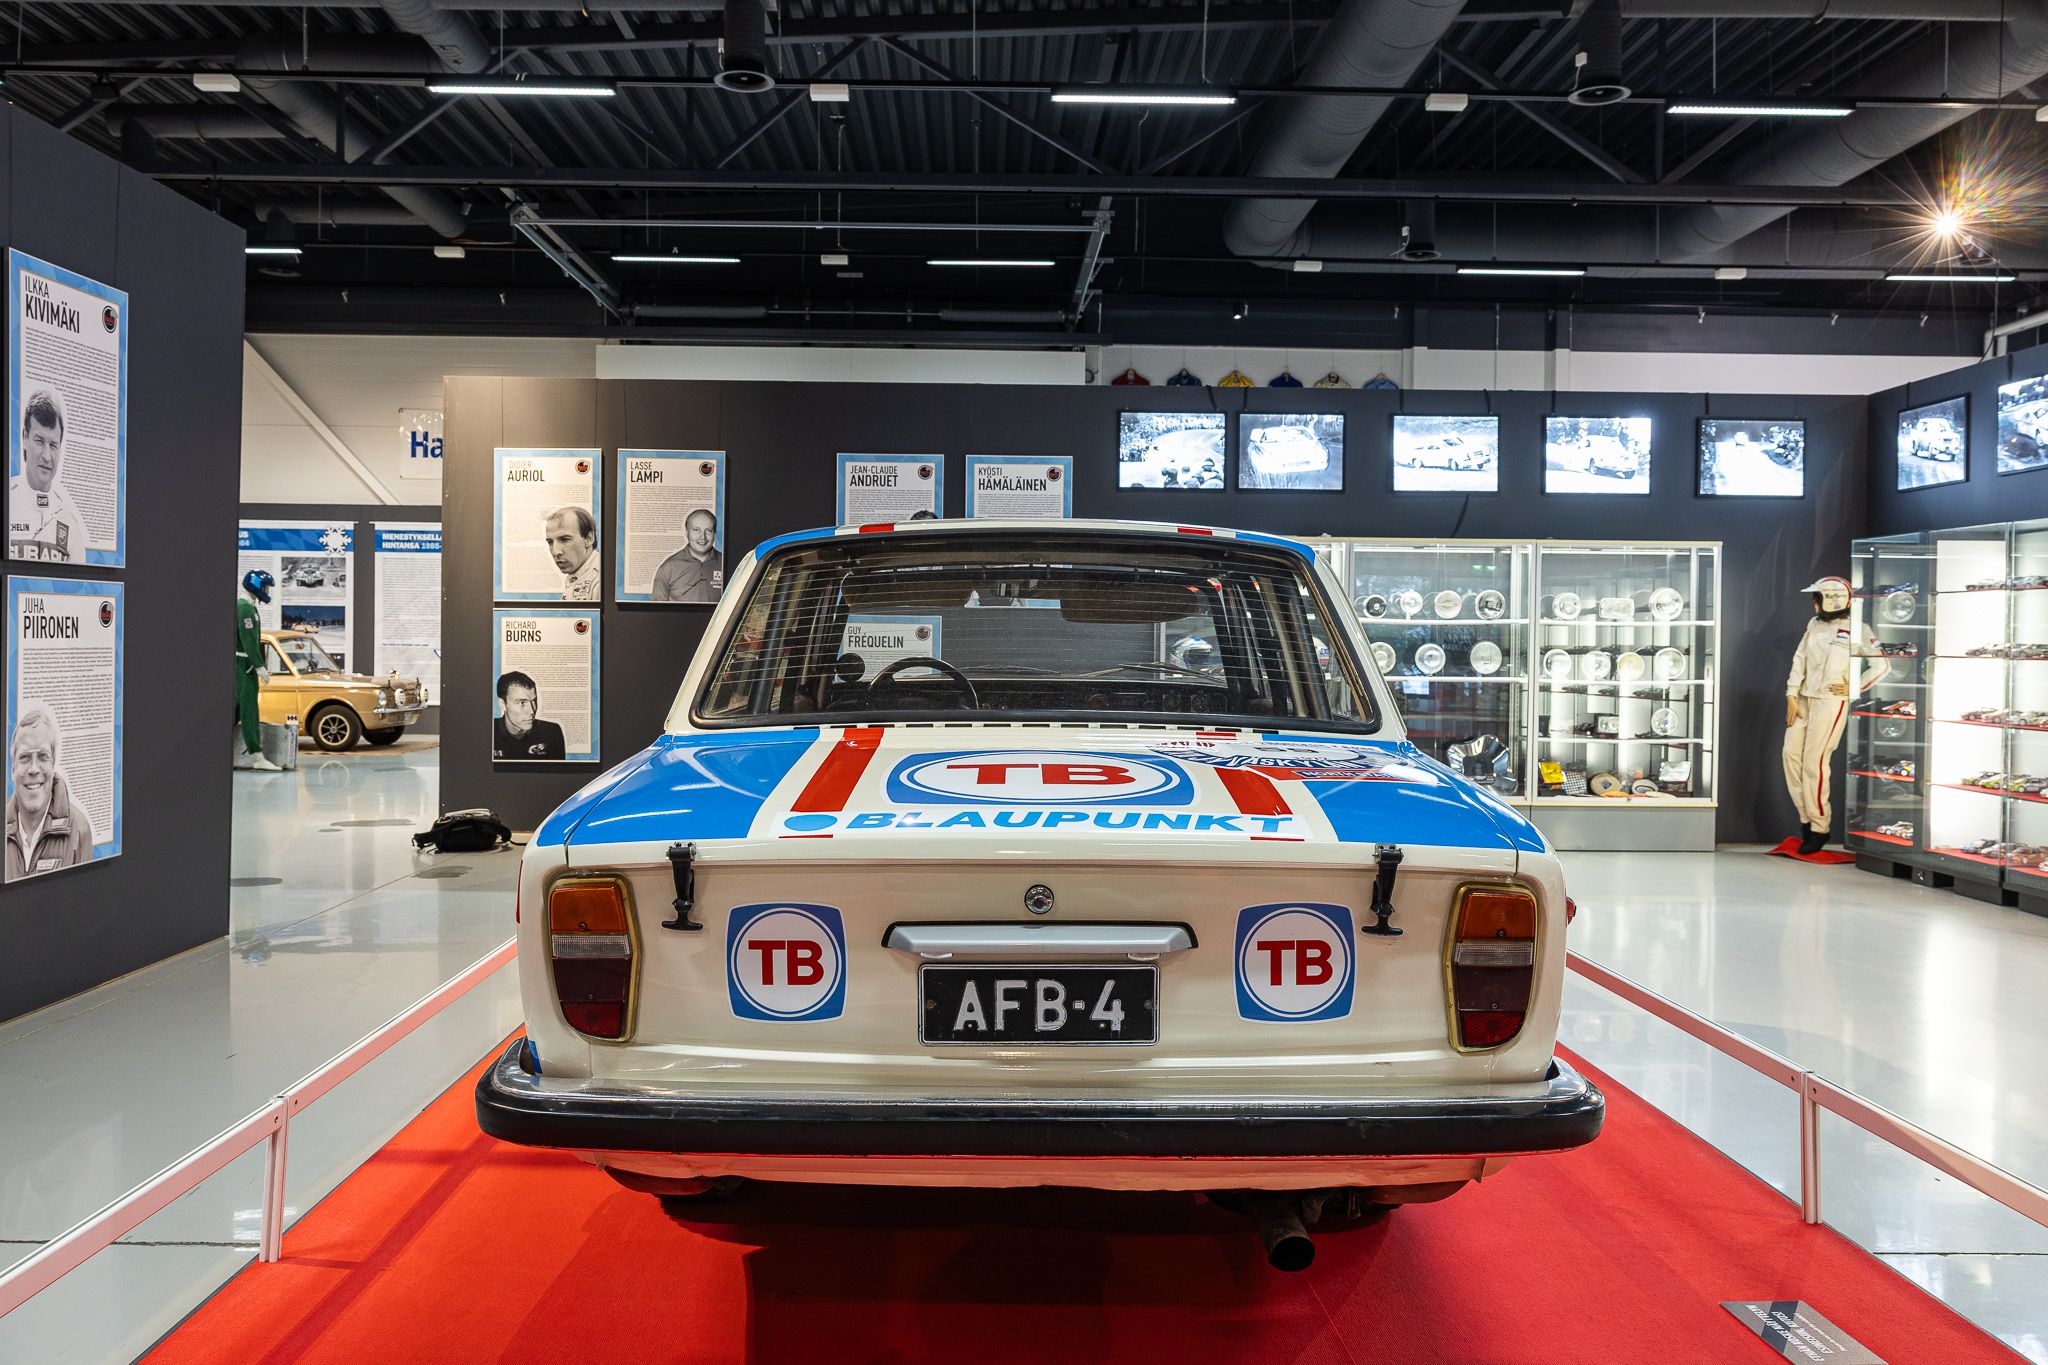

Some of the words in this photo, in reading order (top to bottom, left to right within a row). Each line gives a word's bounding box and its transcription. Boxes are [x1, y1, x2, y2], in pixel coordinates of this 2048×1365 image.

[25, 275, 50, 299] ILKKA
[25, 294, 80, 334] KIVIMÄKI
[411, 431, 443, 458] Ha
[508, 460, 532, 469] DIDIER
[630, 461, 653, 471] LASSE
[850, 465, 898, 475] JEAN-CLAUDE
[978, 466, 1003, 476] KYÖSTI
[507, 470, 545, 482] AURIOL
[630, 470, 663, 483] LAMPI
[850, 475, 898, 488] ANDRUET
[978, 476, 1047, 491] HÄMÄLÄINEN
[382, 541, 420, 549] HINTANSA
[23, 597, 44, 614] JUHA
[23, 615, 79, 639] PIIRONEN
[506, 620, 537, 630] RICHARD
[848, 626, 862, 635] GUY
[506, 630, 542, 643] BURNS
[848, 632, 904, 648] FRÉQUELIN
[946, 764, 1137, 785] TB
[845, 811, 1293, 833] BLAUPUNKT
[748, 939, 825, 986] TB
[1257, 939, 1334, 986] TB
[953, 979, 1125, 1031] AFB-4
